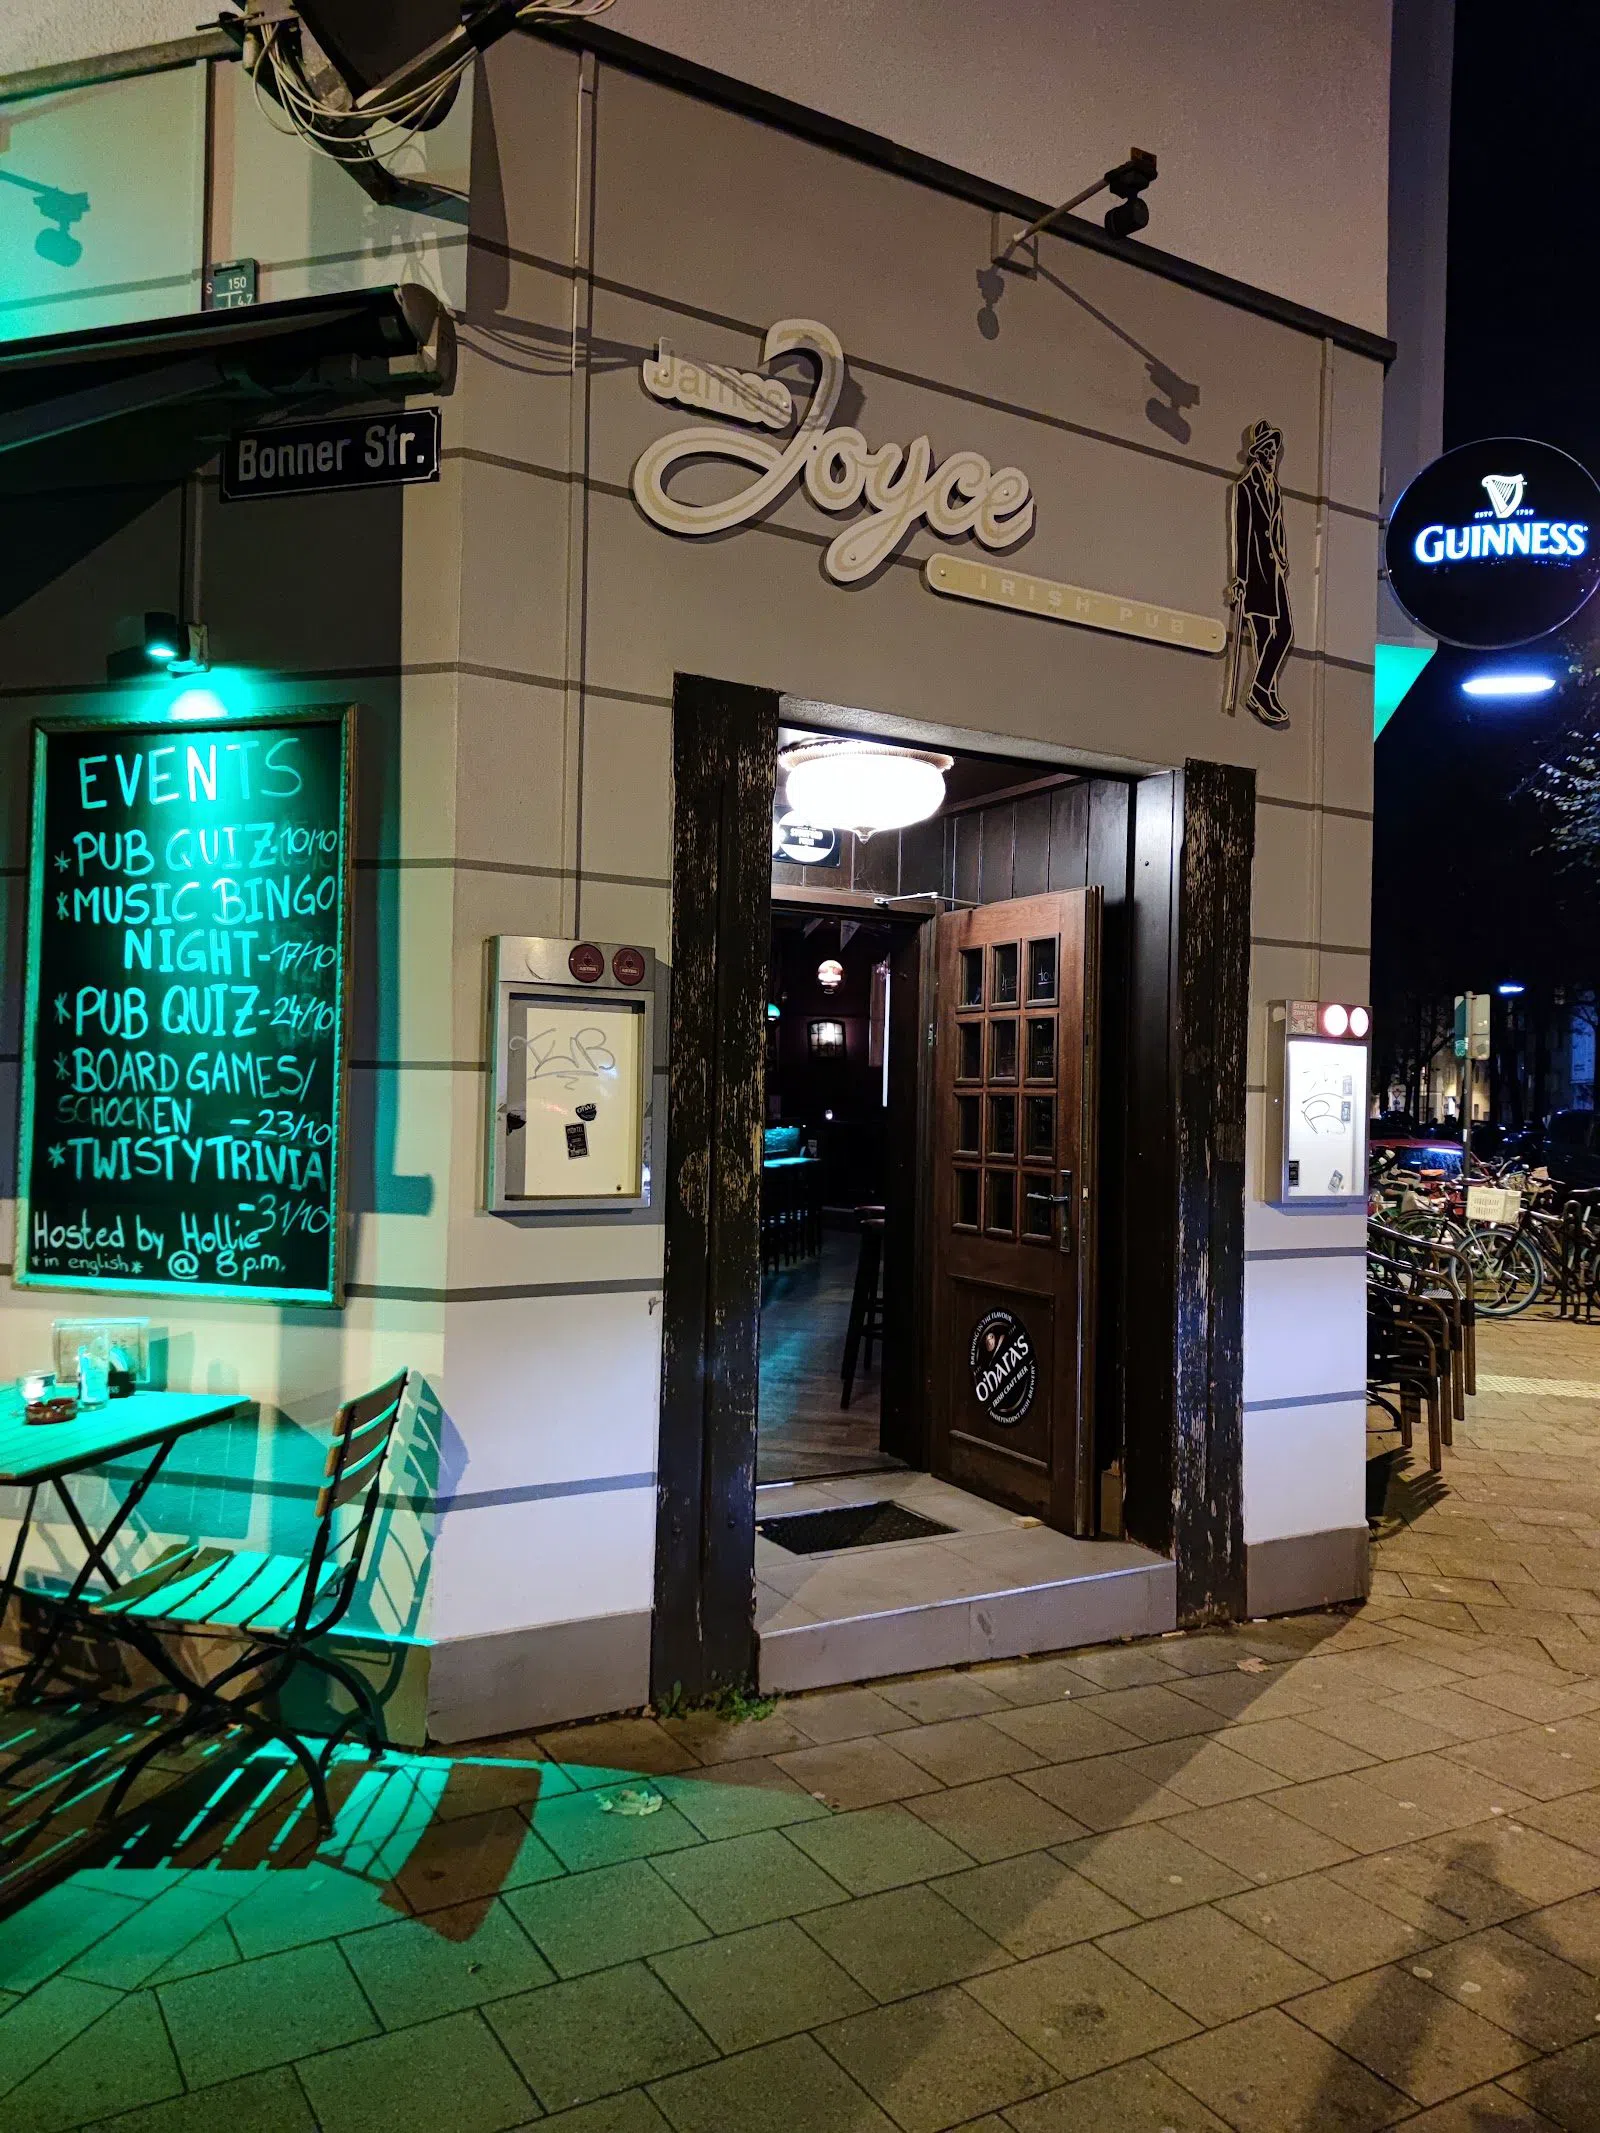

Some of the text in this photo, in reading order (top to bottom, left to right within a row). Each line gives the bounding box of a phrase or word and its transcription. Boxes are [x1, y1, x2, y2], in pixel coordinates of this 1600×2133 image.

[228, 276, 247, 290] 150
[238, 423, 425, 482] Bonner Str.
[636, 320, 1034, 580] Joyce
[1414, 522, 1586, 563] GUINNESS
[979, 573, 1185, 635] IRISH PUB
[77, 737, 303, 810] EVENTS
[72, 828, 156, 878] PUB
[73, 874, 336, 926] MUSIC BINGO
[75, 986, 149, 1040] PUB
[72, 1047, 179, 1095] BOARD
[54, 1095, 192, 1135] SCHOCKEN
[66, 1134, 328, 1193] TWISTY TRIVIA
[33, 1208, 262, 1260] Hosted by Hollie
